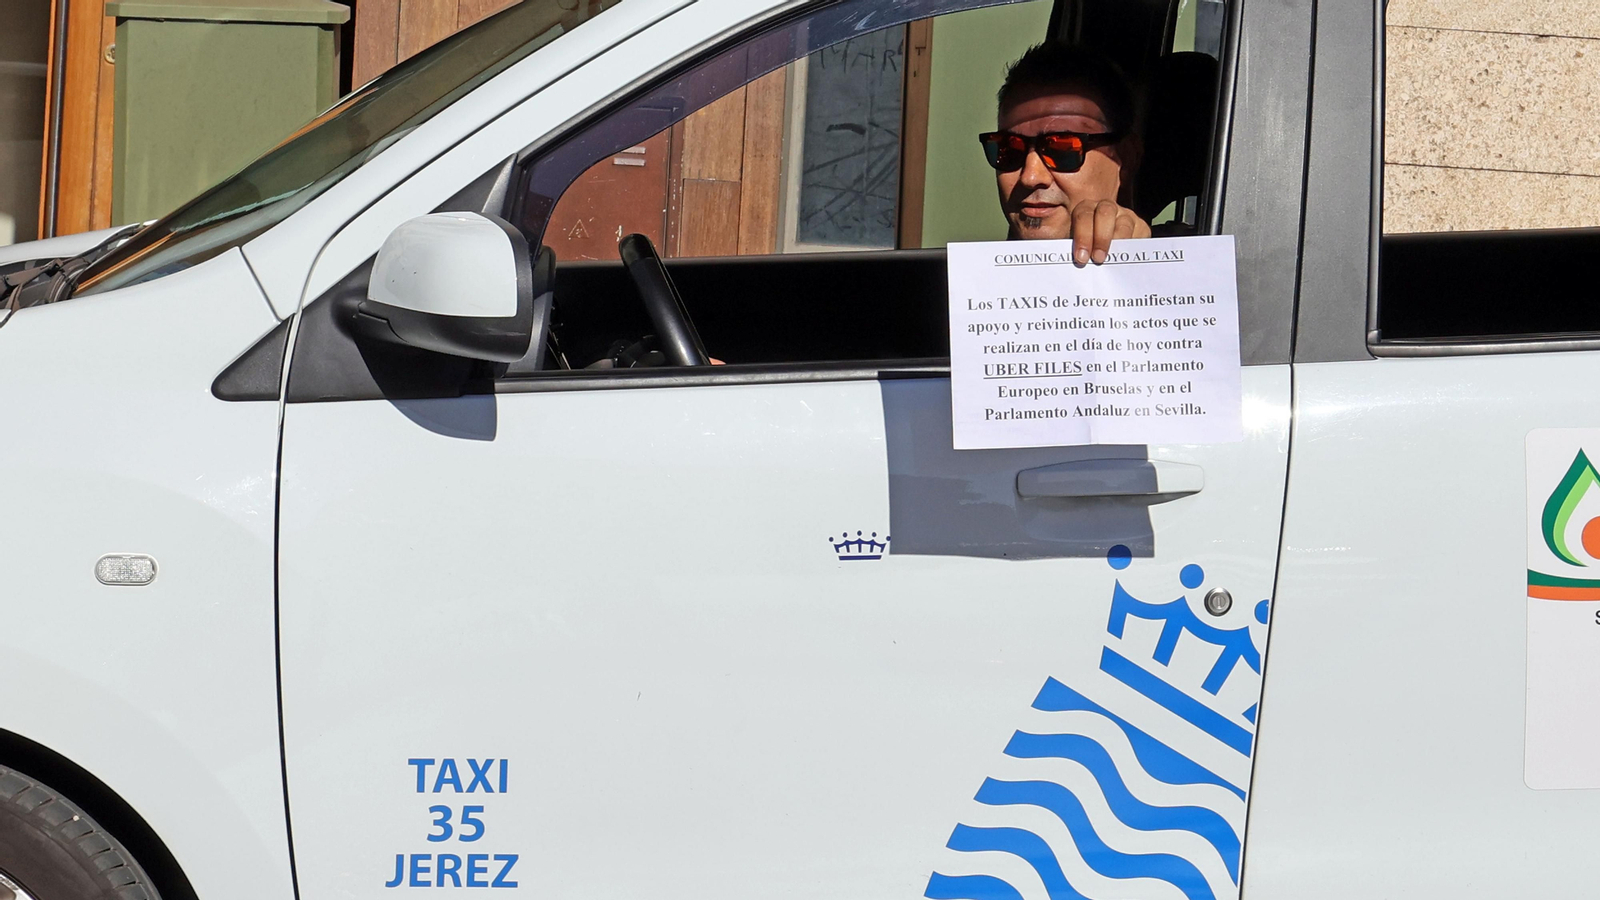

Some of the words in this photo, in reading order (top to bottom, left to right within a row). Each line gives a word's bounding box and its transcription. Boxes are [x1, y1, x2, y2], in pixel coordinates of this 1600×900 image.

[1132, 252, 1149, 261] AL
[1152, 250, 1185, 260] TAXI
[967, 298, 993, 311] Los
[996, 296, 1048, 310] TAXIS
[1052, 295, 1069, 308] de
[1073, 295, 1109, 309] Jerez
[1113, 293, 1195, 307] manifiestan
[1199, 294, 1215, 305] su
[967, 322, 1010, 335] apoyo
[1014, 323, 1023, 335] y
[1027, 316, 1106, 330] reivindican
[1109, 317, 1129, 329] los
[1132, 317, 1169, 329] actos
[1172, 318, 1199, 331] que
[1202, 316, 1217, 326] se
[983, 340, 1041, 354] realizan
[1044, 342, 1061, 352] en
[1065, 338, 1078, 351] el
[1081, 338, 1103, 351] día
[1106, 338, 1123, 351] de
[1127, 338, 1152, 354] hoy
[1156, 338, 1203, 350] contra
[983, 363, 1030, 377] UBER
[1034, 361, 1082, 375] FILES
[1085, 363, 1102, 373] en
[1105, 360, 1117, 373] el
[1121, 359, 1204, 373] Parlamento
[997, 386, 1059, 401] Europeo
[1062, 386, 1079, 396] en
[1083, 382, 1143, 396] Bruselas
[1146, 385, 1155, 398] y
[1158, 384, 1176, 394] en
[1179, 381, 1192, 393] el
[984, 407, 1068, 421] Parlamento
[1072, 404, 1131, 418] Andaluz
[1134, 407, 1151, 417] en
[1155, 402, 1207, 416] Sevilla.
[408, 758, 508, 793] TAXI
[427, 805, 485, 842] 35
[385, 854, 519, 888] JEREZ
